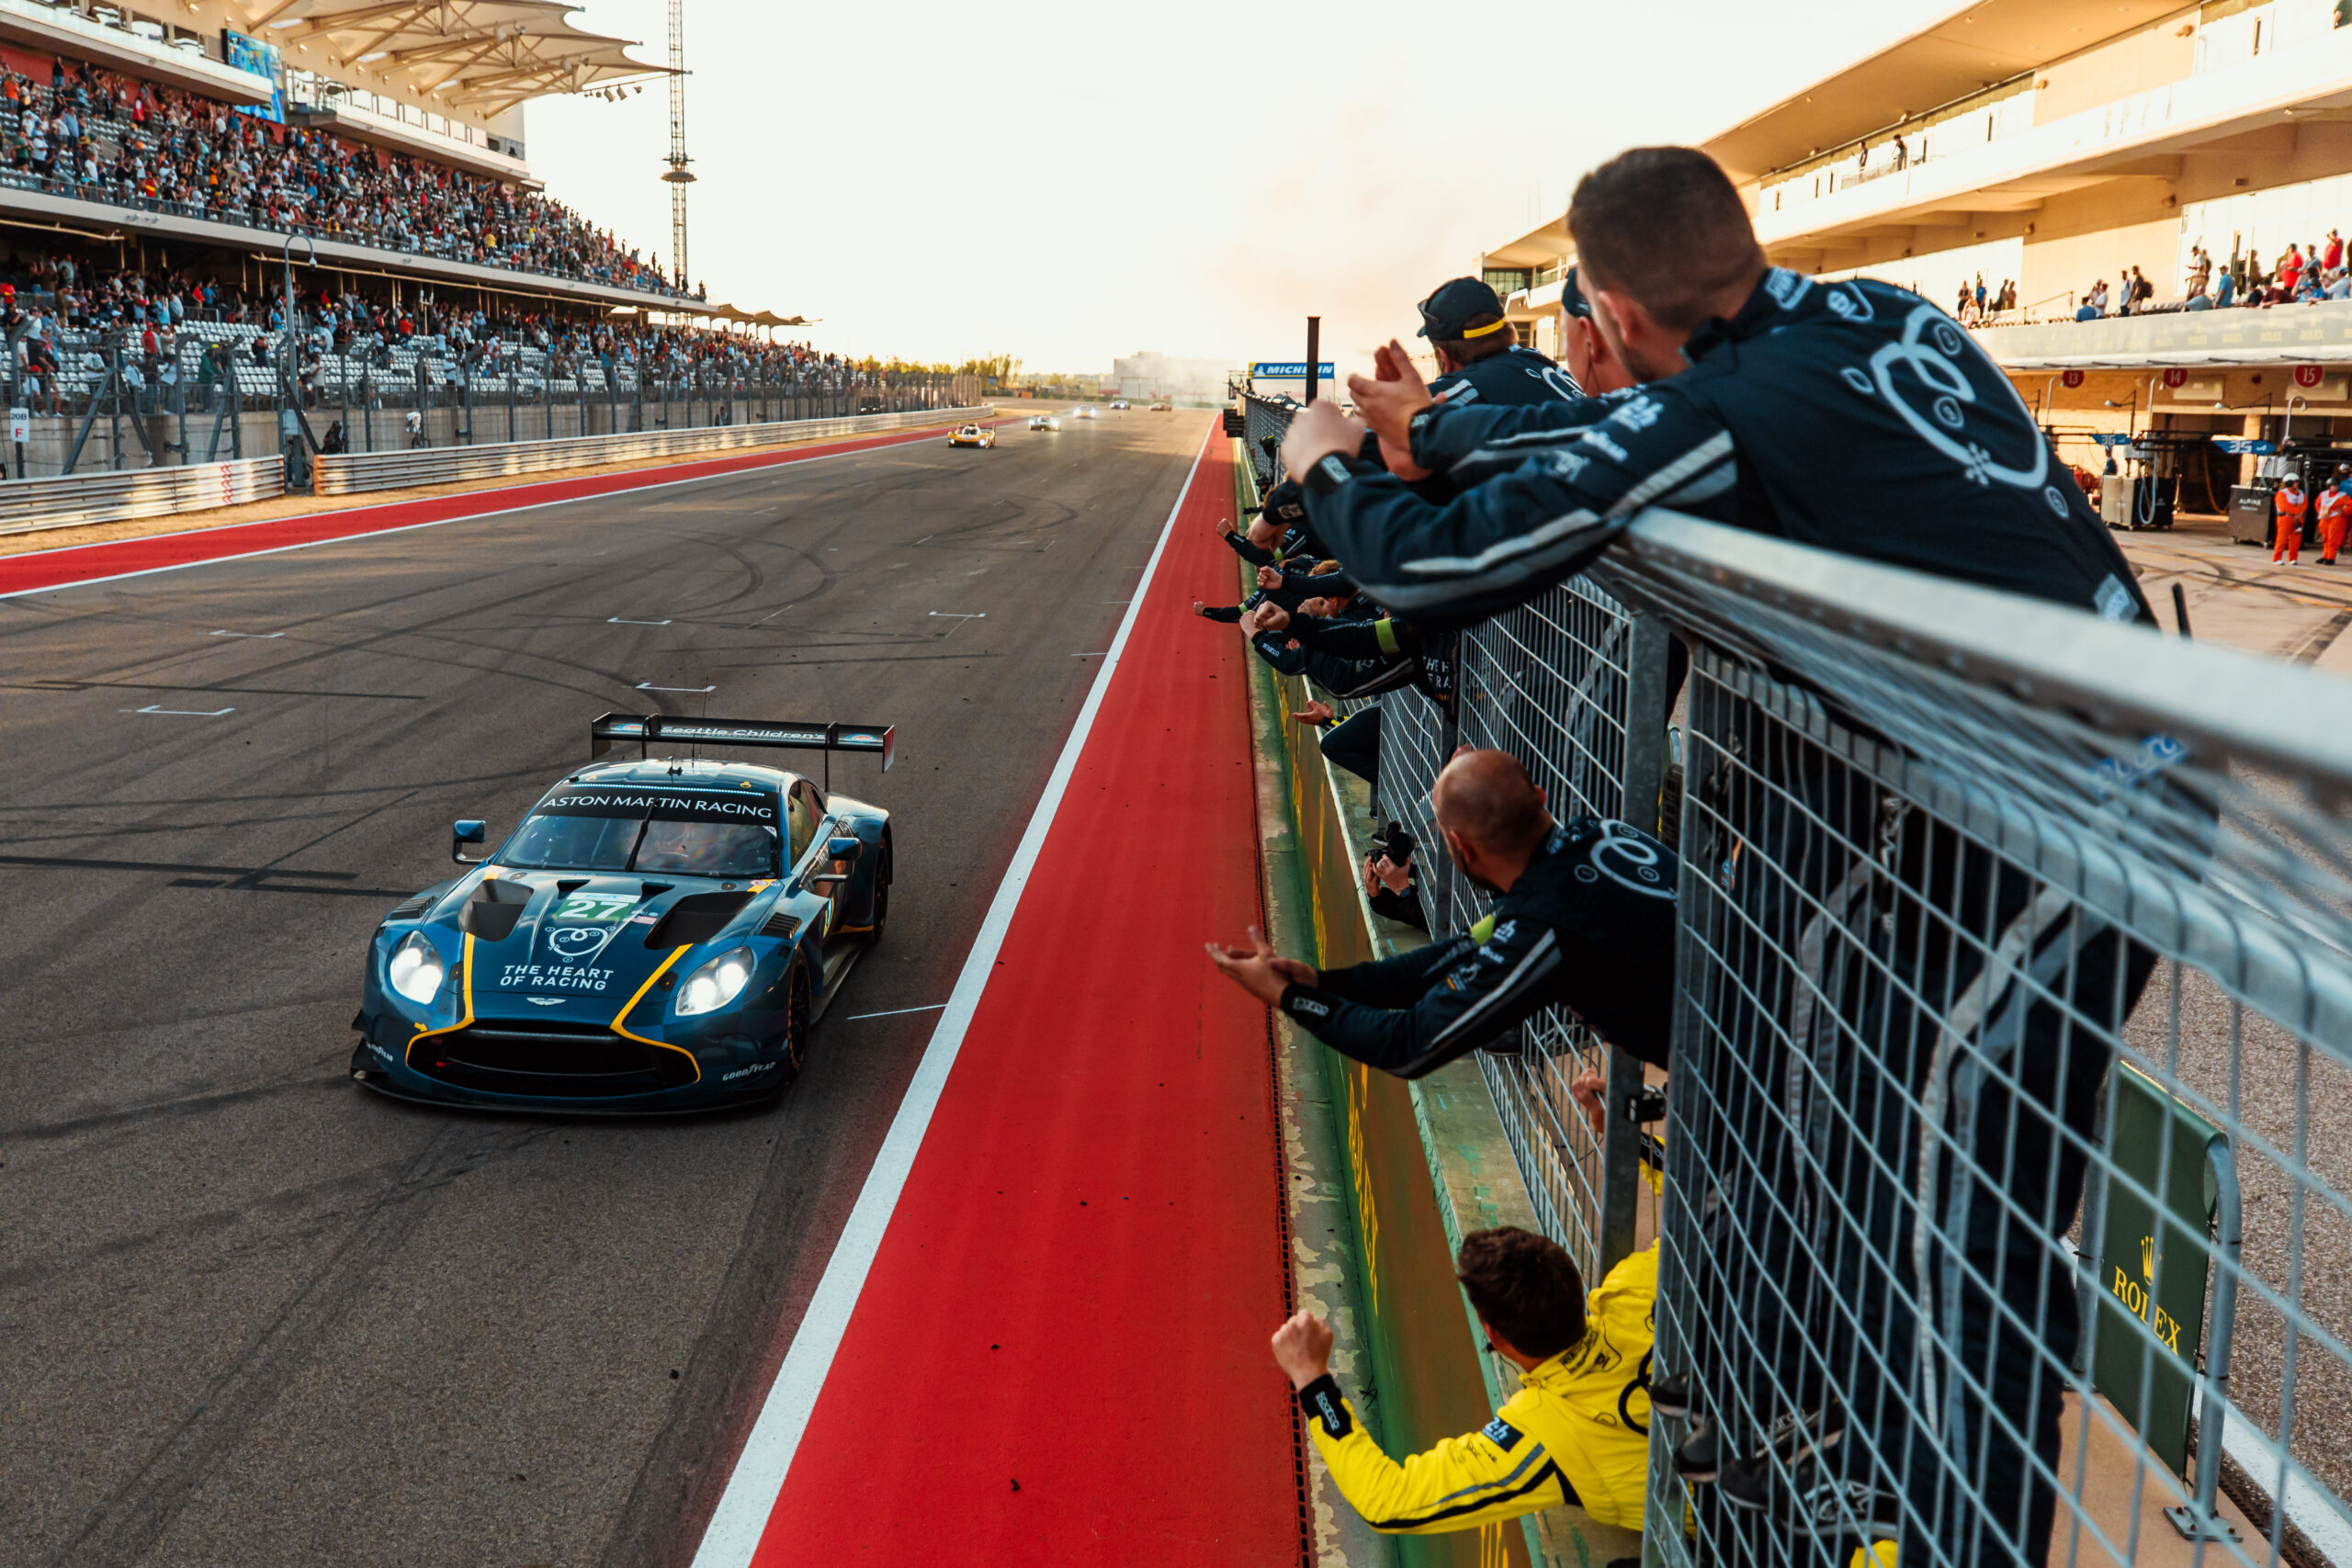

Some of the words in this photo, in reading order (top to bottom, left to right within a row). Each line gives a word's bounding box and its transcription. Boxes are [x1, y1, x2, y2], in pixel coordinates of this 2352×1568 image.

[1267, 366, 1333, 375] MICHEIN
[2170, 371, 2181, 384] 14
[2303, 367, 2316, 383] 15
[2068, 374, 2078, 385] 13
[15, 428, 23, 438] F
[2229, 440, 2253, 454] 35
[2239, 498, 2262, 506] ALPINE
[662, 726, 730, 735] Seattle
[733, 728, 826, 739] Children's
[543, 795, 610, 808] ASTON
[612, 795, 691, 809] MARTIN
[695, 800, 772, 818] RACING
[559, 900, 629, 919] 27
[504, 964, 541, 976] THE
[547, 965, 615, 980] HEART
[500, 976, 526, 987] OF
[531, 976, 606, 990] RACING
[2112, 1265, 2181, 1357] ROLEX
